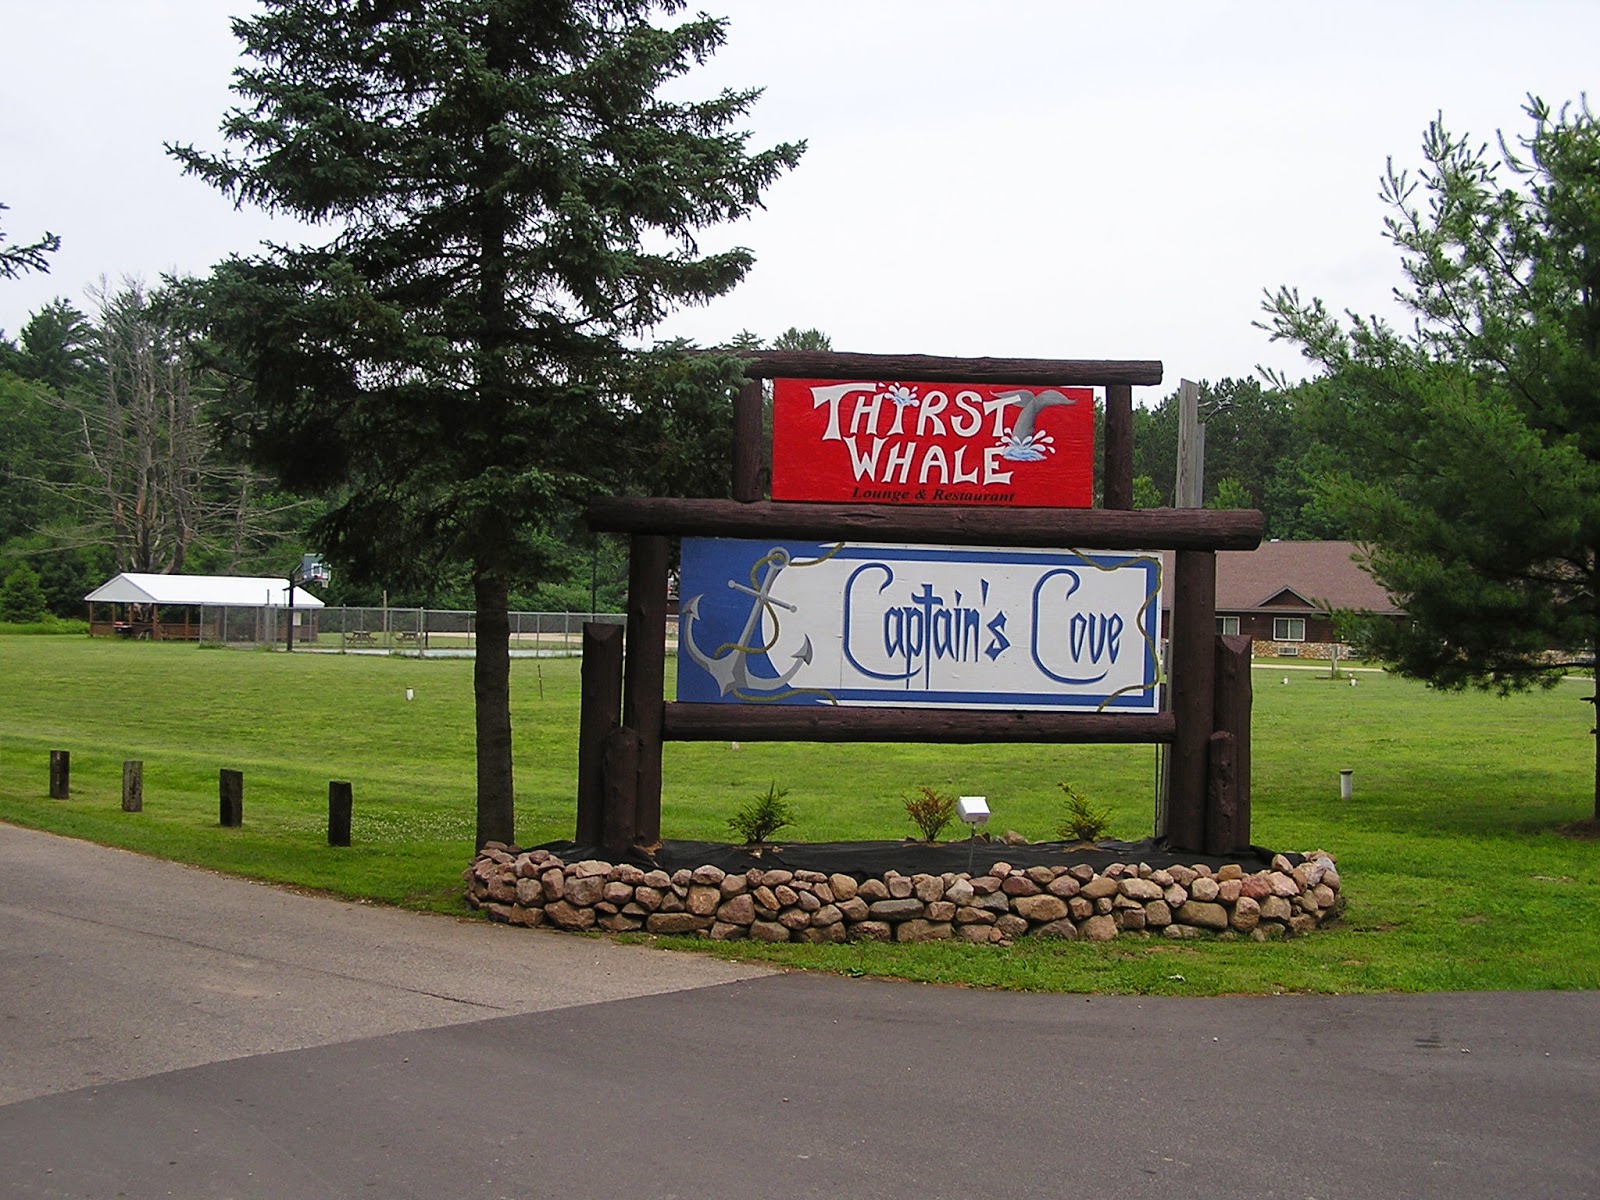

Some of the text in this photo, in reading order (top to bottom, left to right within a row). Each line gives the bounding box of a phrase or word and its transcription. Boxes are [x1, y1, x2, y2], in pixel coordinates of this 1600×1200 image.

[843, 436, 1014, 485] WHALE
[851, 487, 1015, 503] Lounge & Restaurant
[844, 562, 1124, 690] Captain's Cove
